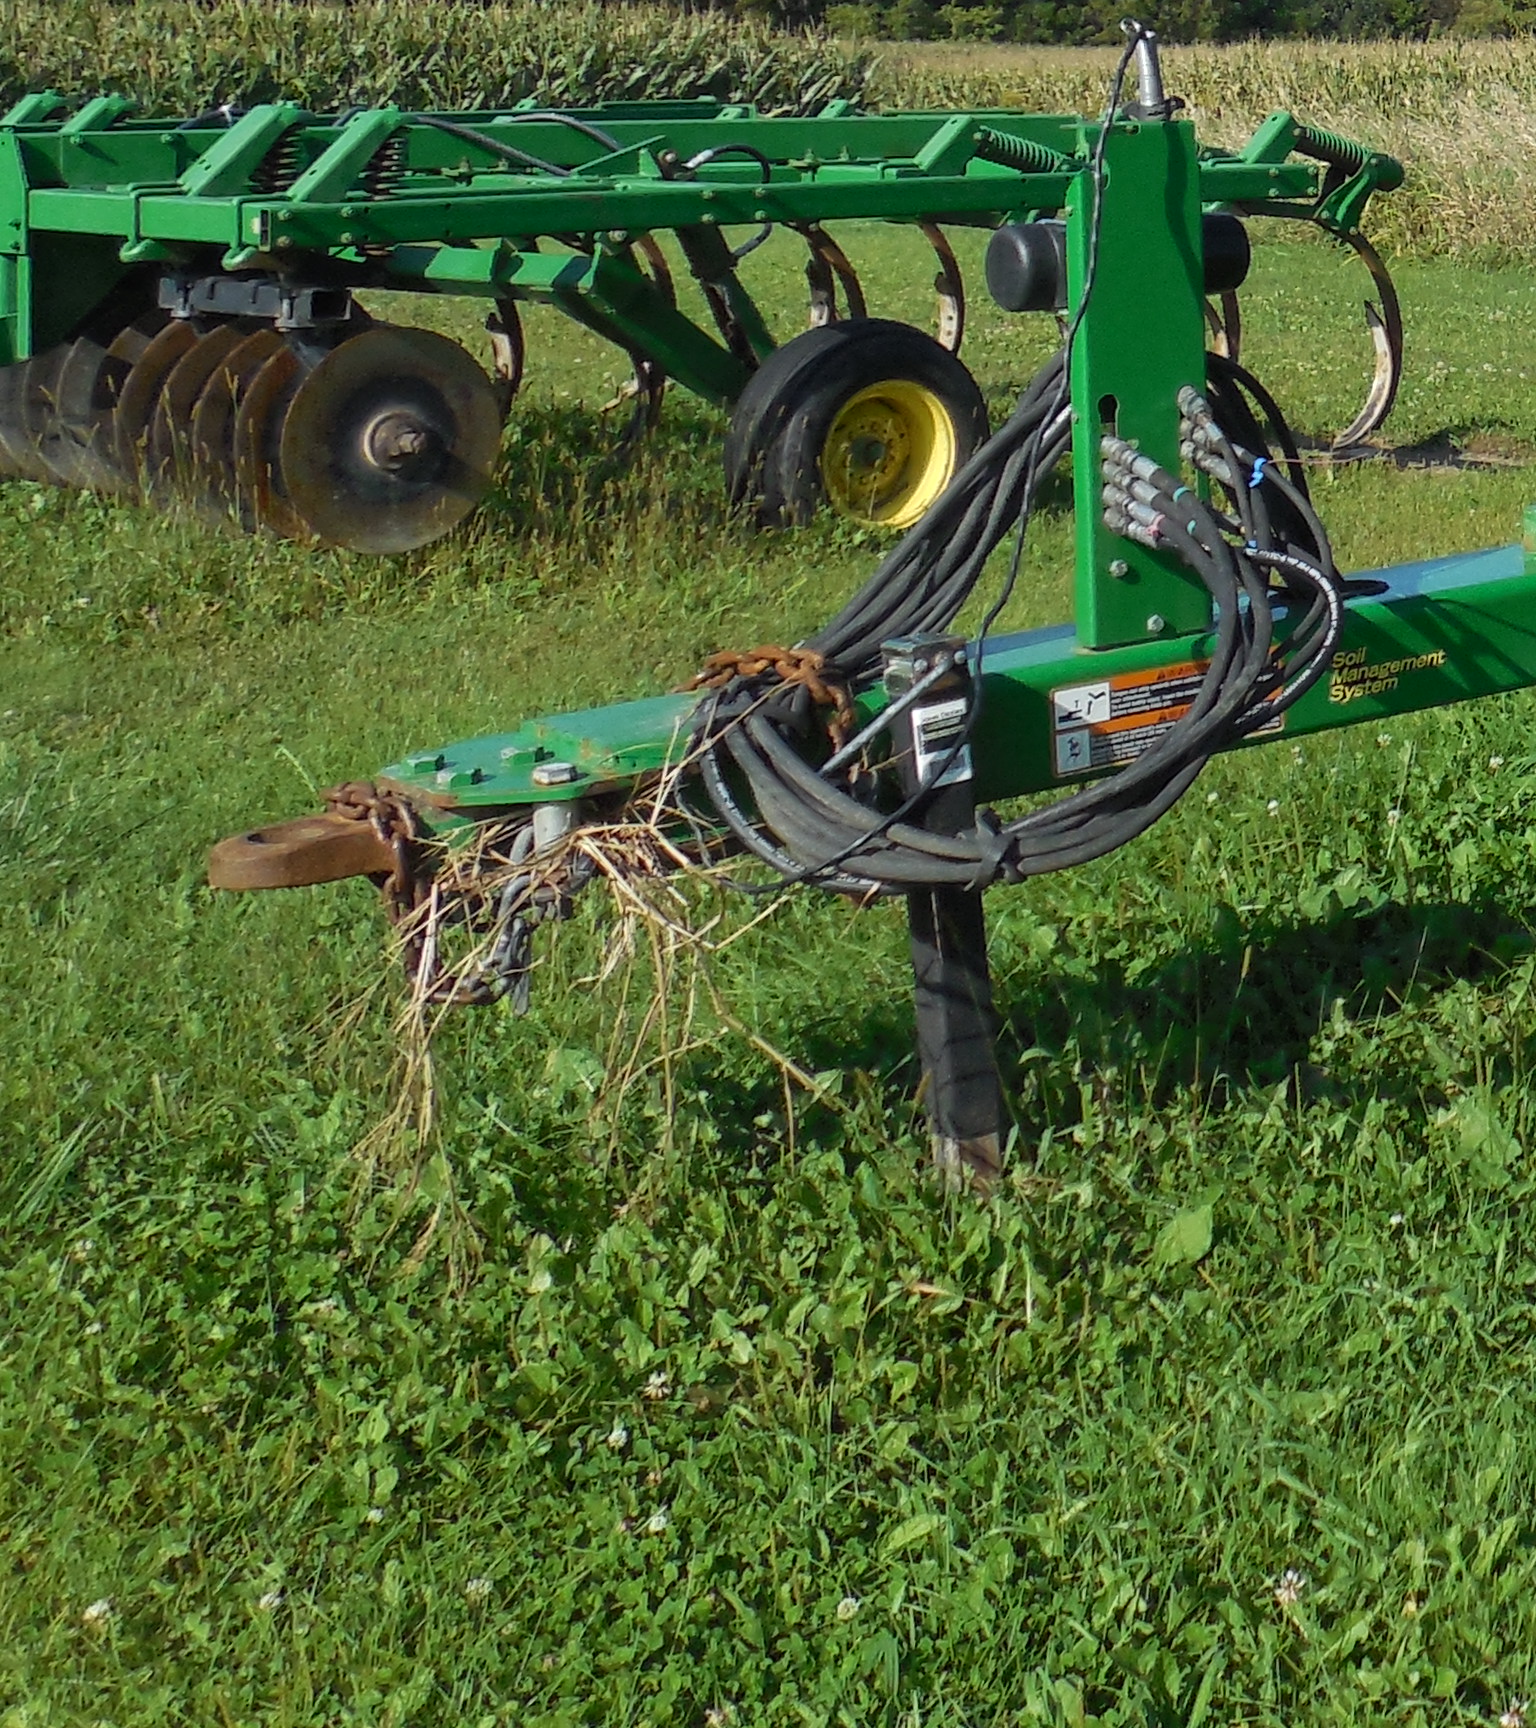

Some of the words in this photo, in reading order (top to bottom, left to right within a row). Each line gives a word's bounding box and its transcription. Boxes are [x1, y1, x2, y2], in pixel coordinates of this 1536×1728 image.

[1331, 649, 1446, 685] Management
[1332, 647, 1367, 668] Soil
[1329, 677, 1398, 703] System
